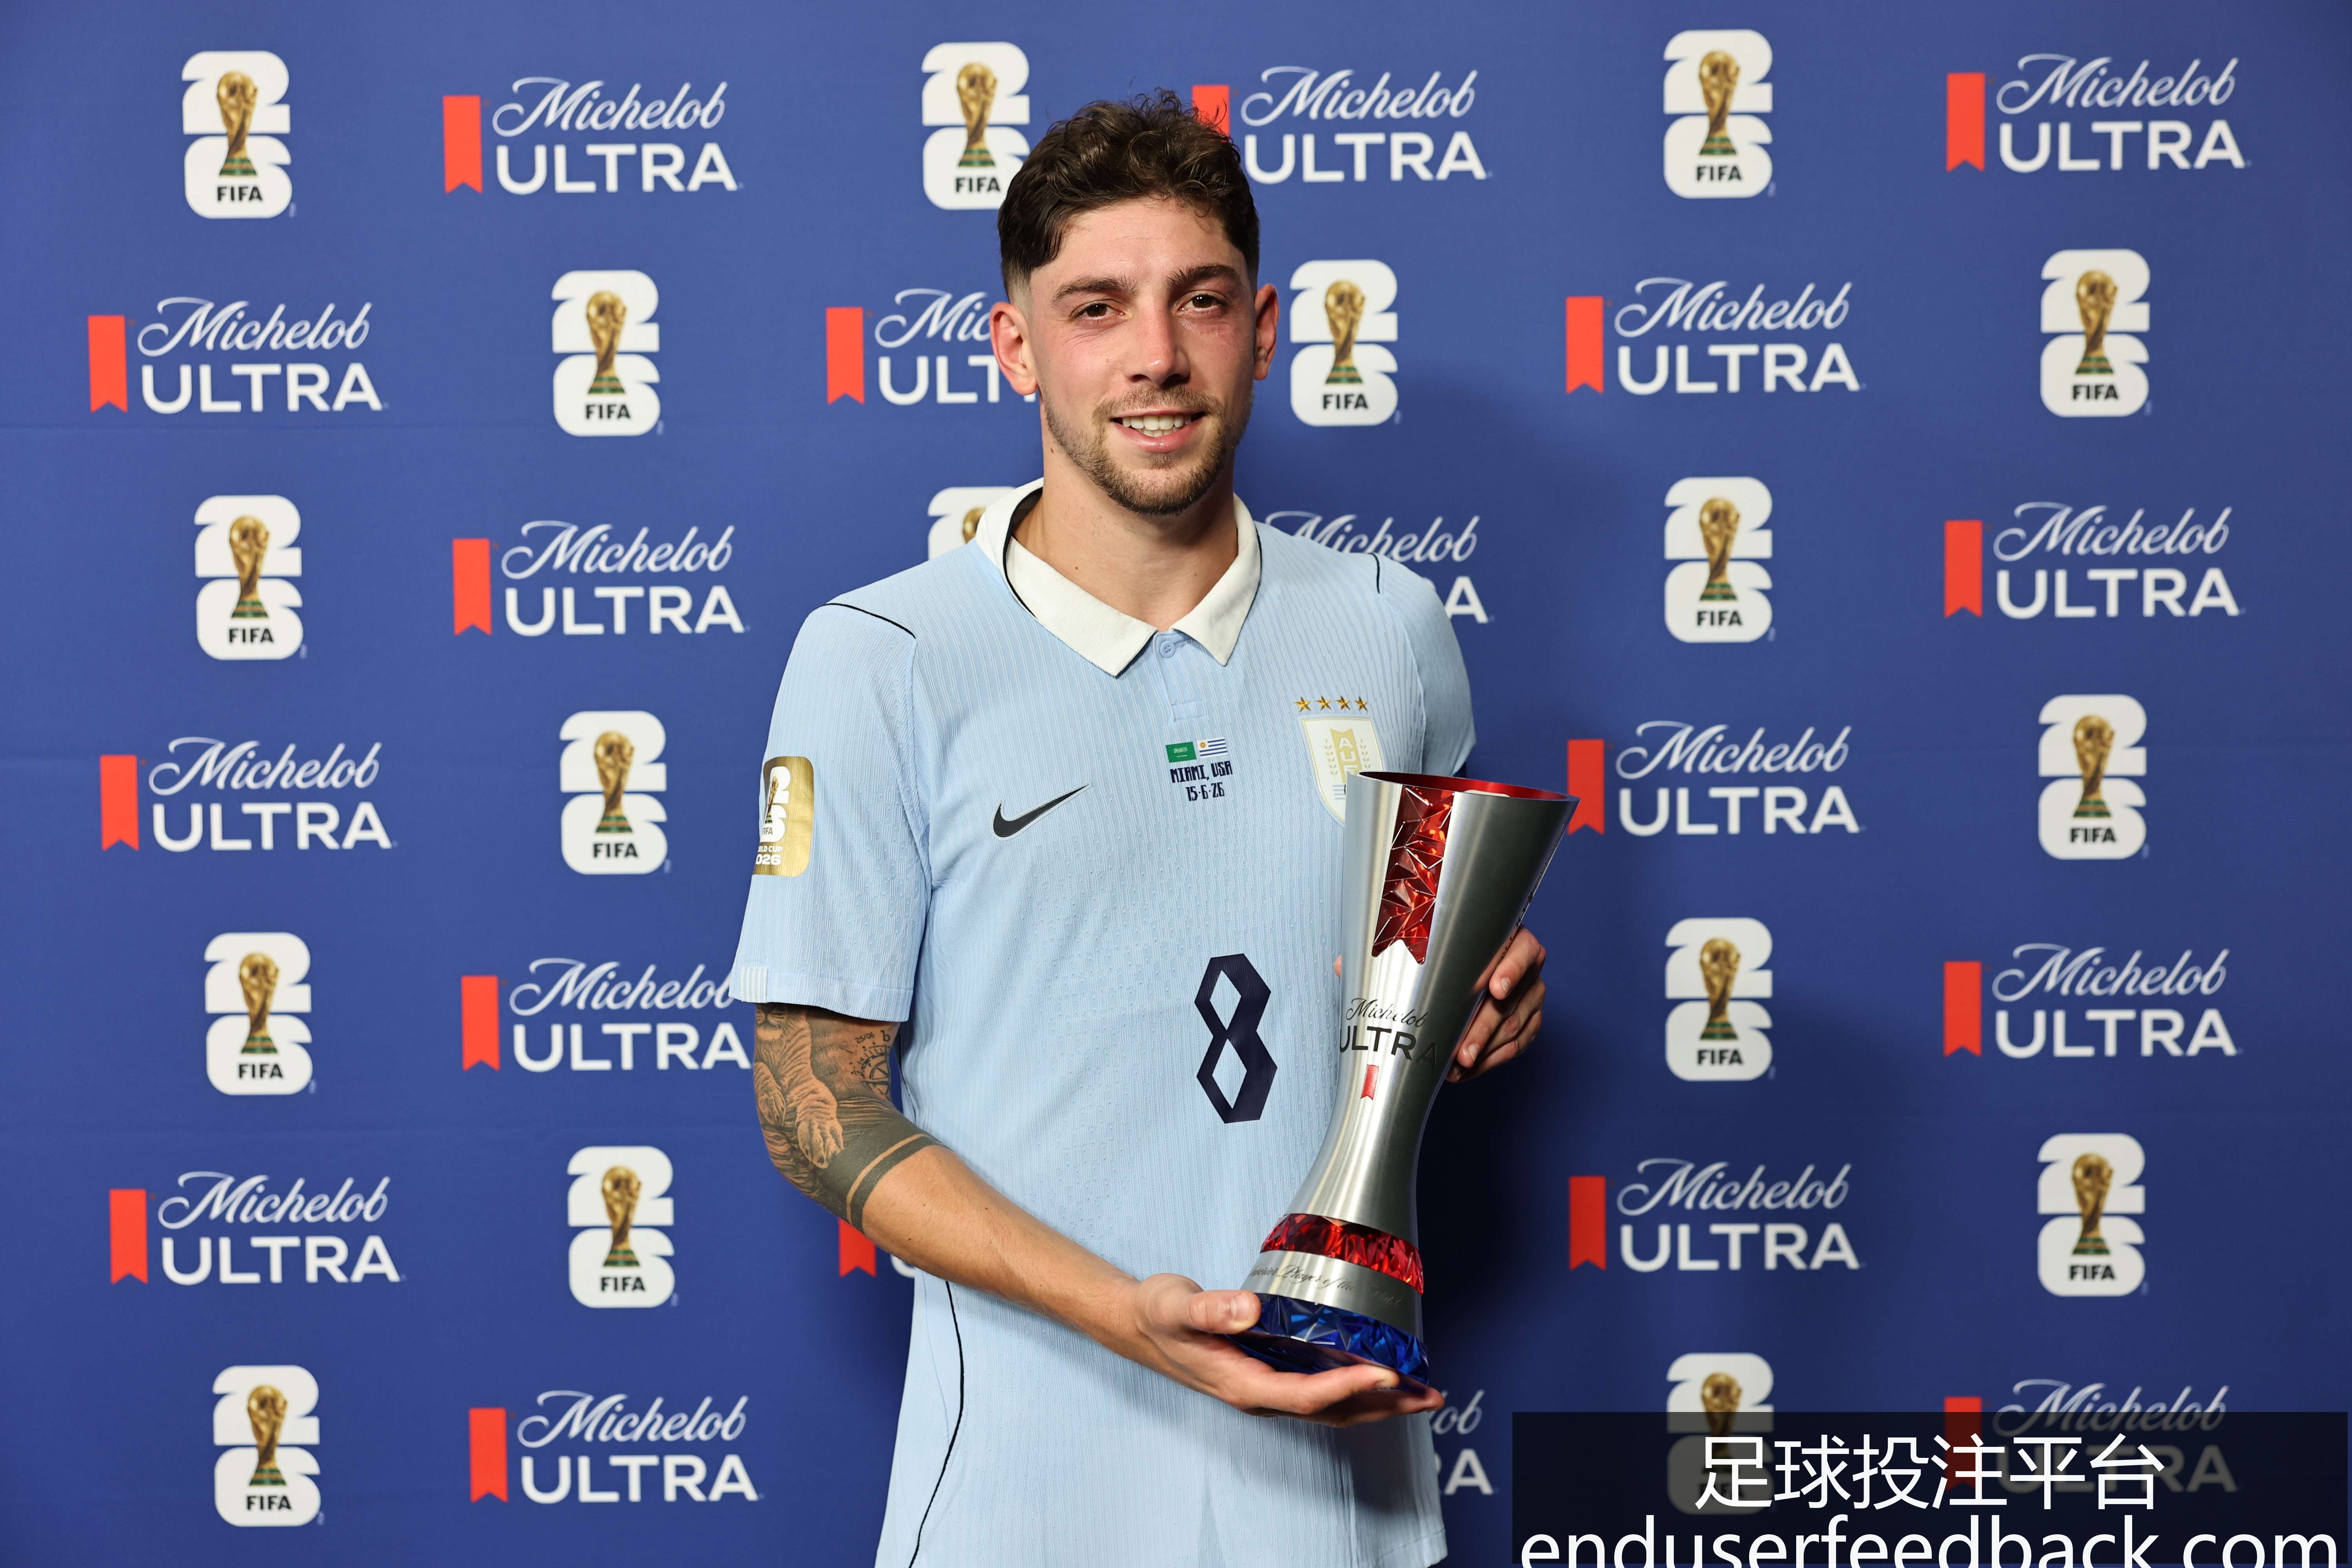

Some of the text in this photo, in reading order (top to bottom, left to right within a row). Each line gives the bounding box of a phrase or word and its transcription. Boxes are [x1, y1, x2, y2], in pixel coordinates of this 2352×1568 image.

[492, 76, 728, 137] Michelob
[1241, 66, 1478, 127] Michelob
[1996, 53, 2238, 114] Michelob
[496, 142, 738, 195] ULTRA
[1244, 131, 1487, 185] ULTRA
[1999, 120, 2245, 173] ULTRA
[217, 186, 263, 202] FIFA
[955, 176, 1000, 193] FIFA
[1696, 165, 1742, 181] FIFA
[137, 296, 372, 357] Michelob
[1614, 277, 1852, 338] Michelob
[141, 363, 383, 414] ULTRA
[878, 355, 1036, 406] ULT
[1617, 343, 1860, 395] ULTRA
[2072, 384, 2119, 400] FIFA
[586, 404, 631, 419] FIFA
[1323, 393, 1368, 410] FIFA
[501, 520, 735, 580] Michelob
[1993, 502, 2232, 562] Michelob
[505, 585, 745, 637] ULTRA
[1697, 610, 1742, 626] FIFA
[1996, 568, 2240, 619] ULTRA
[229, 628, 274, 643] FIFA
[148, 737, 382, 796] Michelob
[1170, 760, 1233, 783] MIAMI, USA
[1616, 720, 1851, 779] Michelob
[152, 801, 392, 852] ULTRA
[1619, 786, 1860, 837] ULTRA
[2070, 827, 2116, 843] FIFA
[593, 843, 638, 858] FIFA
[756, 853, 781, 866] 026
[509, 958, 735, 1016] Michelob
[1992, 943, 2229, 1002] Michelob
[1346, 998, 1428, 1027] Michelob
[1995, 1008, 2237, 1059] ULTRA
[513, 1022, 751, 1073] ULTRA
[1194, 953, 1278, 1124] 8
[1339, 1025, 1437, 1070] ULTRA
[1697, 1048, 1744, 1065] FIFA
[238, 1063, 283, 1079] FIFA
[158, 1171, 390, 1230] Michelob
[1617, 1158, 1851, 1216] Michelob
[162, 1235, 401, 1286] ULTRA
[1621, 1223, 1860, 1272] ULTRA
[2069, 1264, 2116, 1280] FIFA
[601, 1276, 646, 1292] FIFA
[517, 1390, 748, 1448] Michelob
[1993, 1379, 2229, 1437] Michelob
[521, 1454, 759, 1504] ULTRA
[1996, 1445, 2237, 1494] ULTRA
[246, 1495, 292, 1511] FIFA
